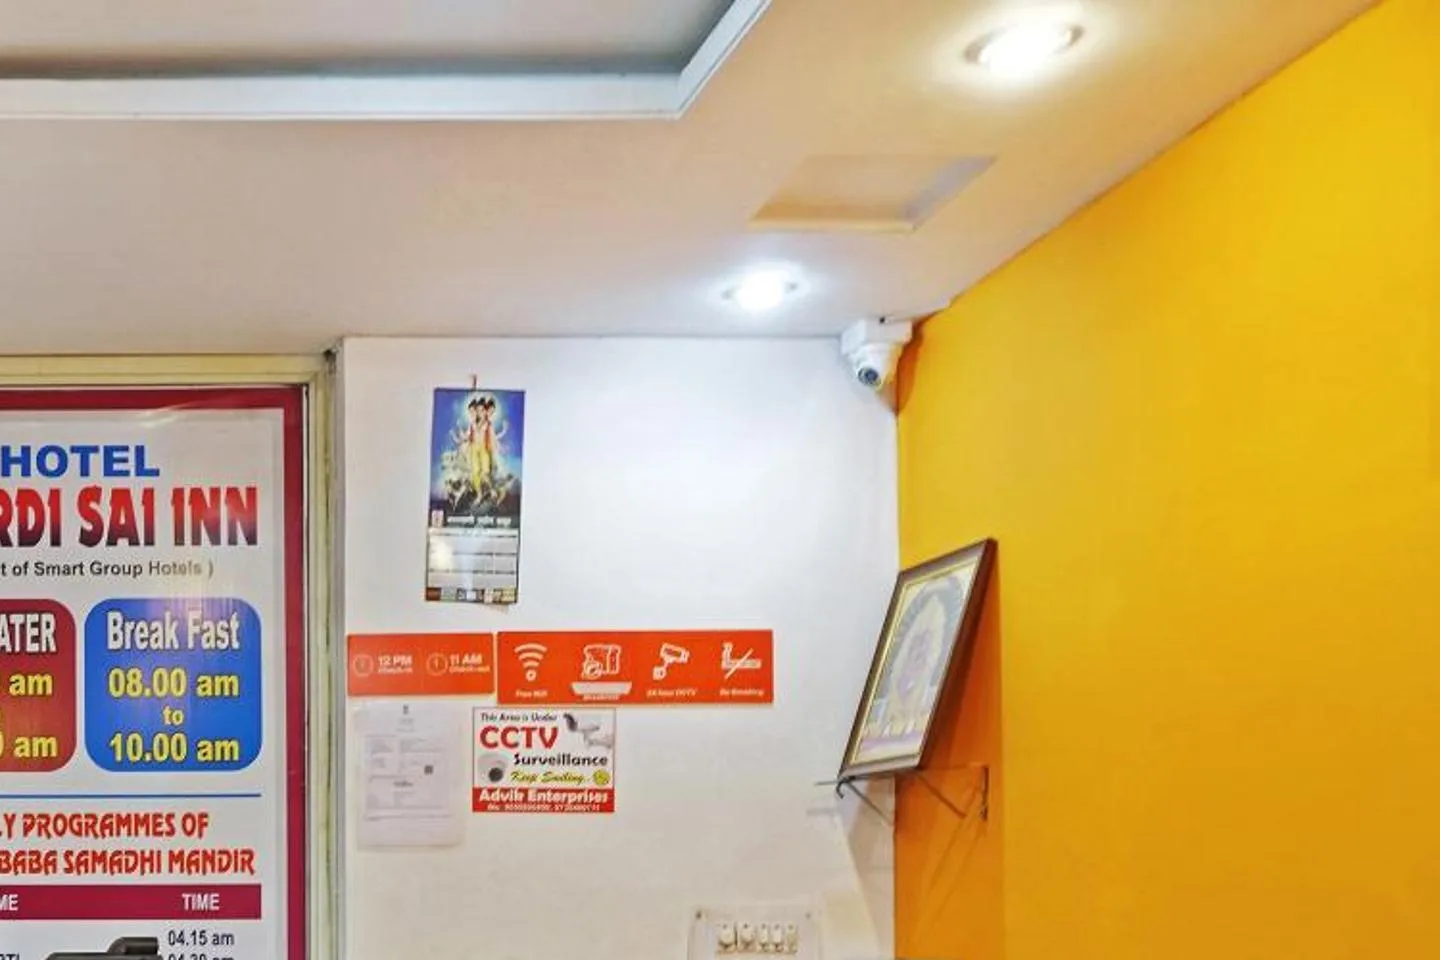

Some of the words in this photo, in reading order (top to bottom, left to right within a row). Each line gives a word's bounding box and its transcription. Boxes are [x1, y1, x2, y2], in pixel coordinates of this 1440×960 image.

[0, 445, 161, 477] HOTEL
[77, 485, 156, 548] SAI
[170, 486, 258, 547] INN
[11, 561, 29, 576] of
[33, 561, 85, 576] Smart
[89, 561, 143, 579] Group
[148, 561, 202, 576] Hotels
[106, 611, 180, 651] Break
[187, 610, 241, 651] Fast
[378, 655, 391, 666] 12
[393, 655, 413, 666] PM
[462, 652, 483, 665] AM
[9, 673, 53, 696] am
[108, 667, 187, 697] 08.00
[196, 674, 240, 697] am
[162, 705, 185, 725] to
[481, 712, 497, 721] This
[500, 712, 520, 721] Area
[523, 712, 528, 721] is
[531, 712, 558, 721] Under
[13, 735, 58, 758] am
[109, 732, 187, 762] 10.00
[197, 738, 240, 762] am
[480, 725, 558, 749] CCTV
[513, 753, 608, 766] Surveillance
[510, 771, 538, 783] Keep
[480, 788, 524, 801] Advik
[527, 788, 608, 803] Enterprises
[22, 812, 176, 839] PROGRAMMES
[181, 812, 210, 839] OF
[62, 849, 162, 876] SAMADHI
[168, 849, 256, 876] MANDIR
[182, 893, 220, 911] TIME
[168, 930, 208, 946] 04.15
[212, 933, 235, 946] am
